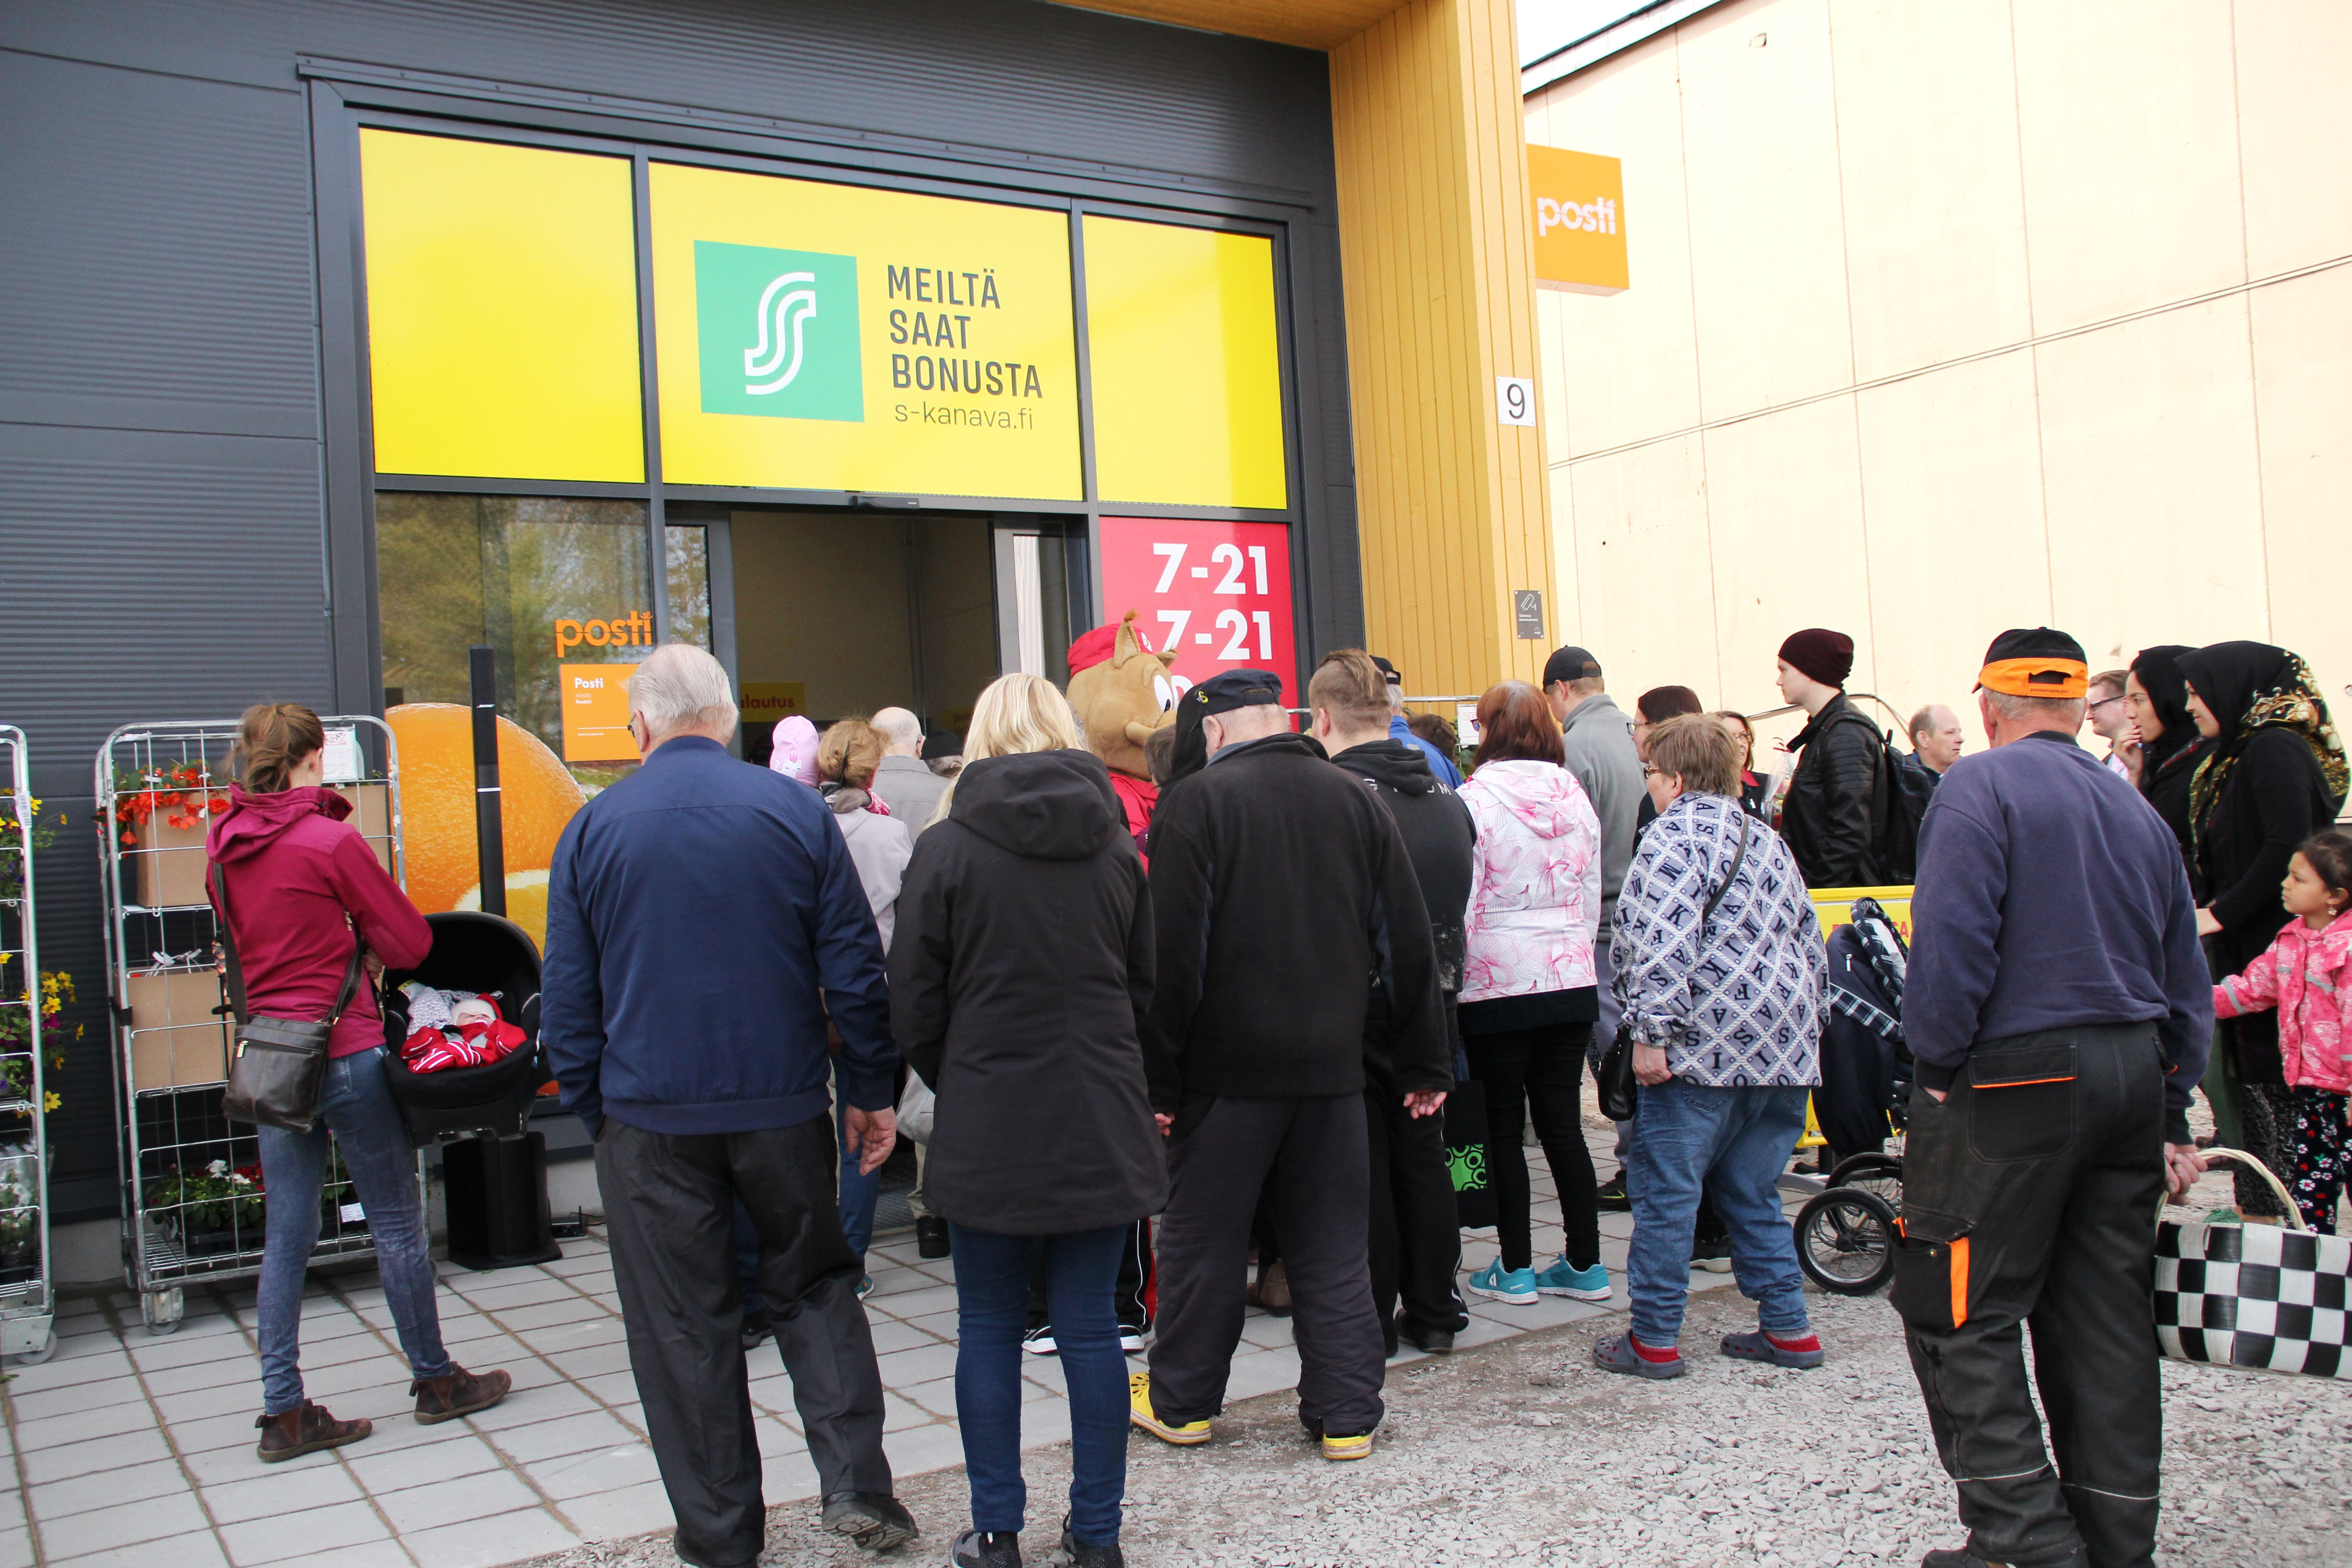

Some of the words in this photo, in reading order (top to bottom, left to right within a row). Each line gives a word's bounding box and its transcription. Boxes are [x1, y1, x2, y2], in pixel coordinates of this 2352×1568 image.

[1536, 196, 1617, 237] posti
[887, 265, 1001, 309] MEILTÄ
[890, 310, 971, 349] SAAT
[892, 354, 1043, 399] BONUSTA
[1506, 383, 1526, 419] 9
[895, 402, 1034, 430] s-kanava.fi
[1153, 543, 1269, 595] 7-21
[555, 610, 653, 658] posti
[1157, 609, 1273, 661] 7-21
[574, 677, 604, 689] Posti
[1761, 875, 1779, 895] N
[1666, 904, 1689, 925] K
[1798, 908, 1813, 927] F
[1751, 960, 1768, 981] K
[1685, 1030, 1700, 1047] S
[1779, 1027, 1789, 1044] S
[1712, 1052, 1722, 1069] I
